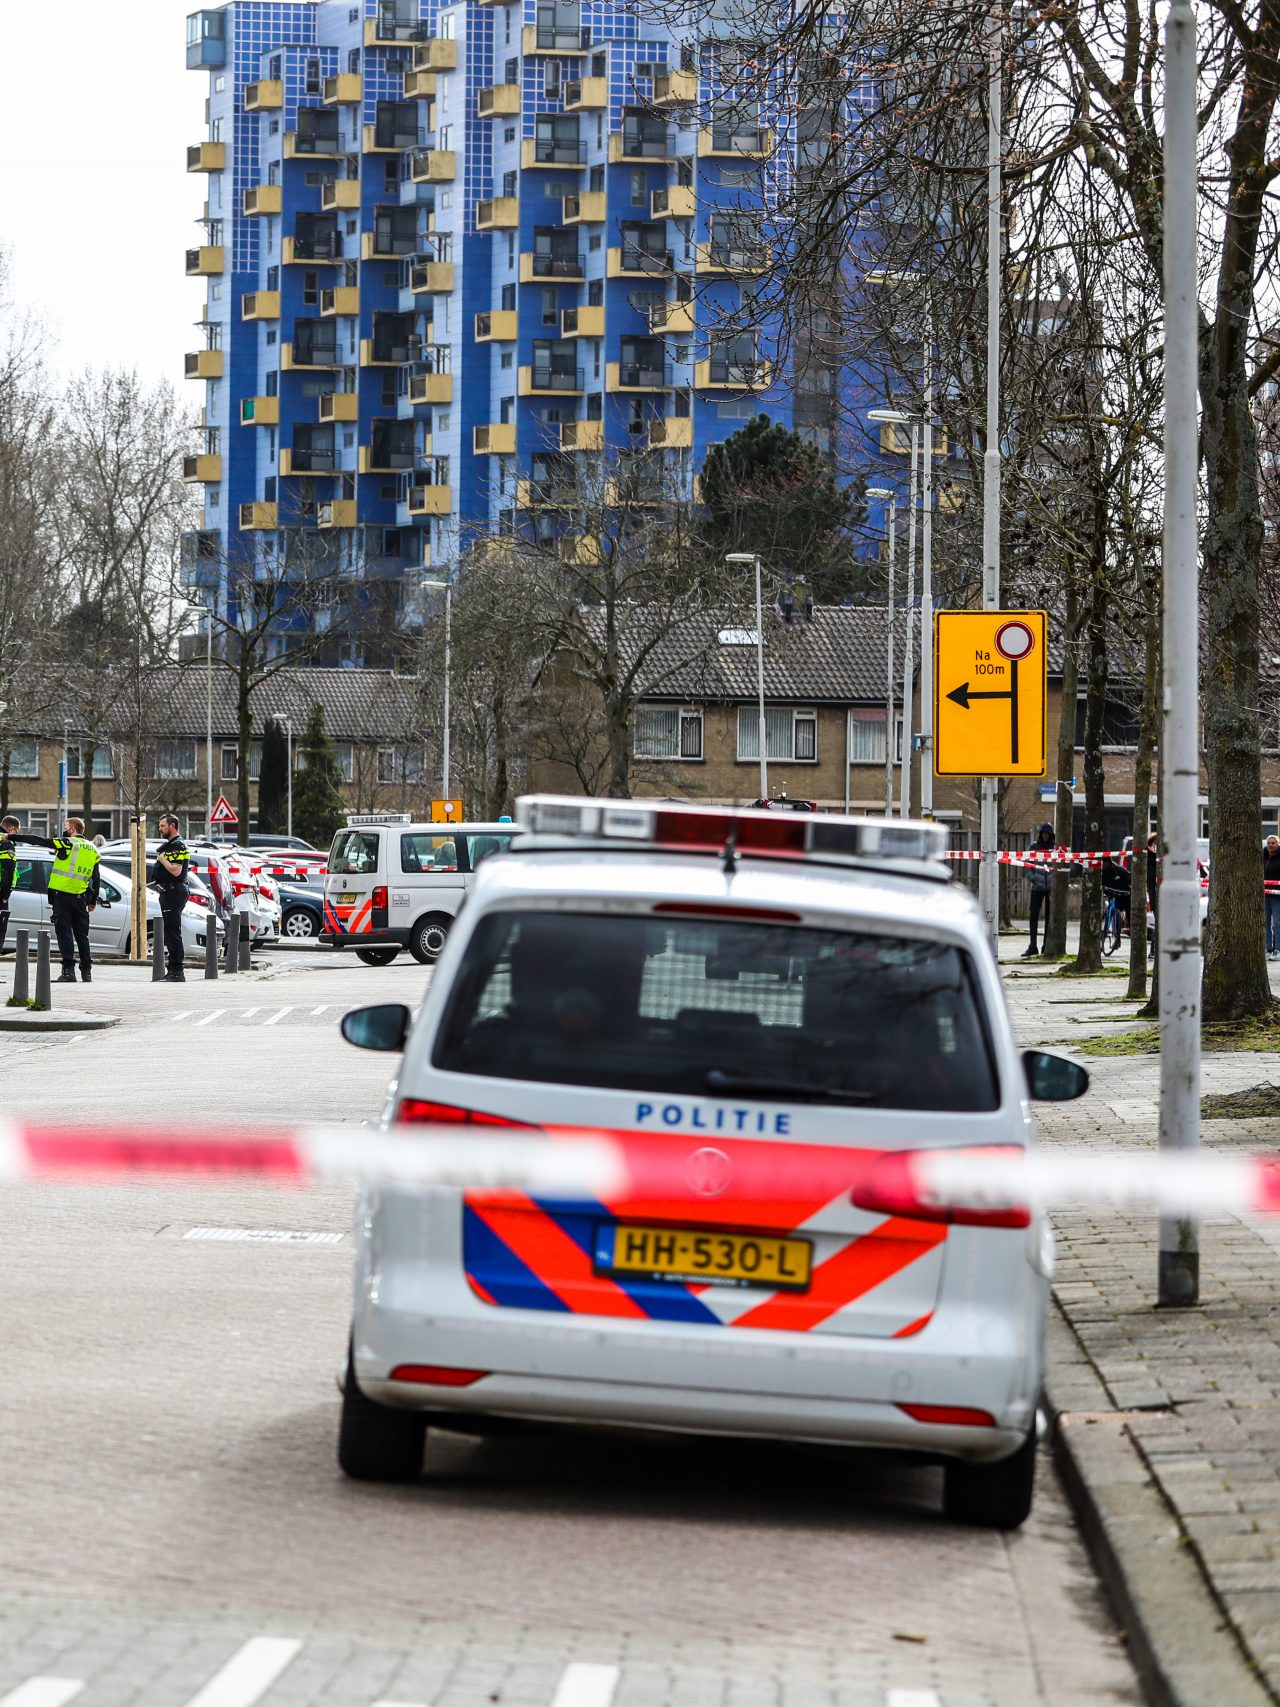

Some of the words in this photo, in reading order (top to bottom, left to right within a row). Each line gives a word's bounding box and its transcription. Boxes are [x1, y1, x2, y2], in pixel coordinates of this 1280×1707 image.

[975, 650, 991, 661] Na
[975, 664, 1005, 675] 100m
[636, 1103, 792, 1135] POLITIE
[625, 1232, 796, 1277] HH-530-L
